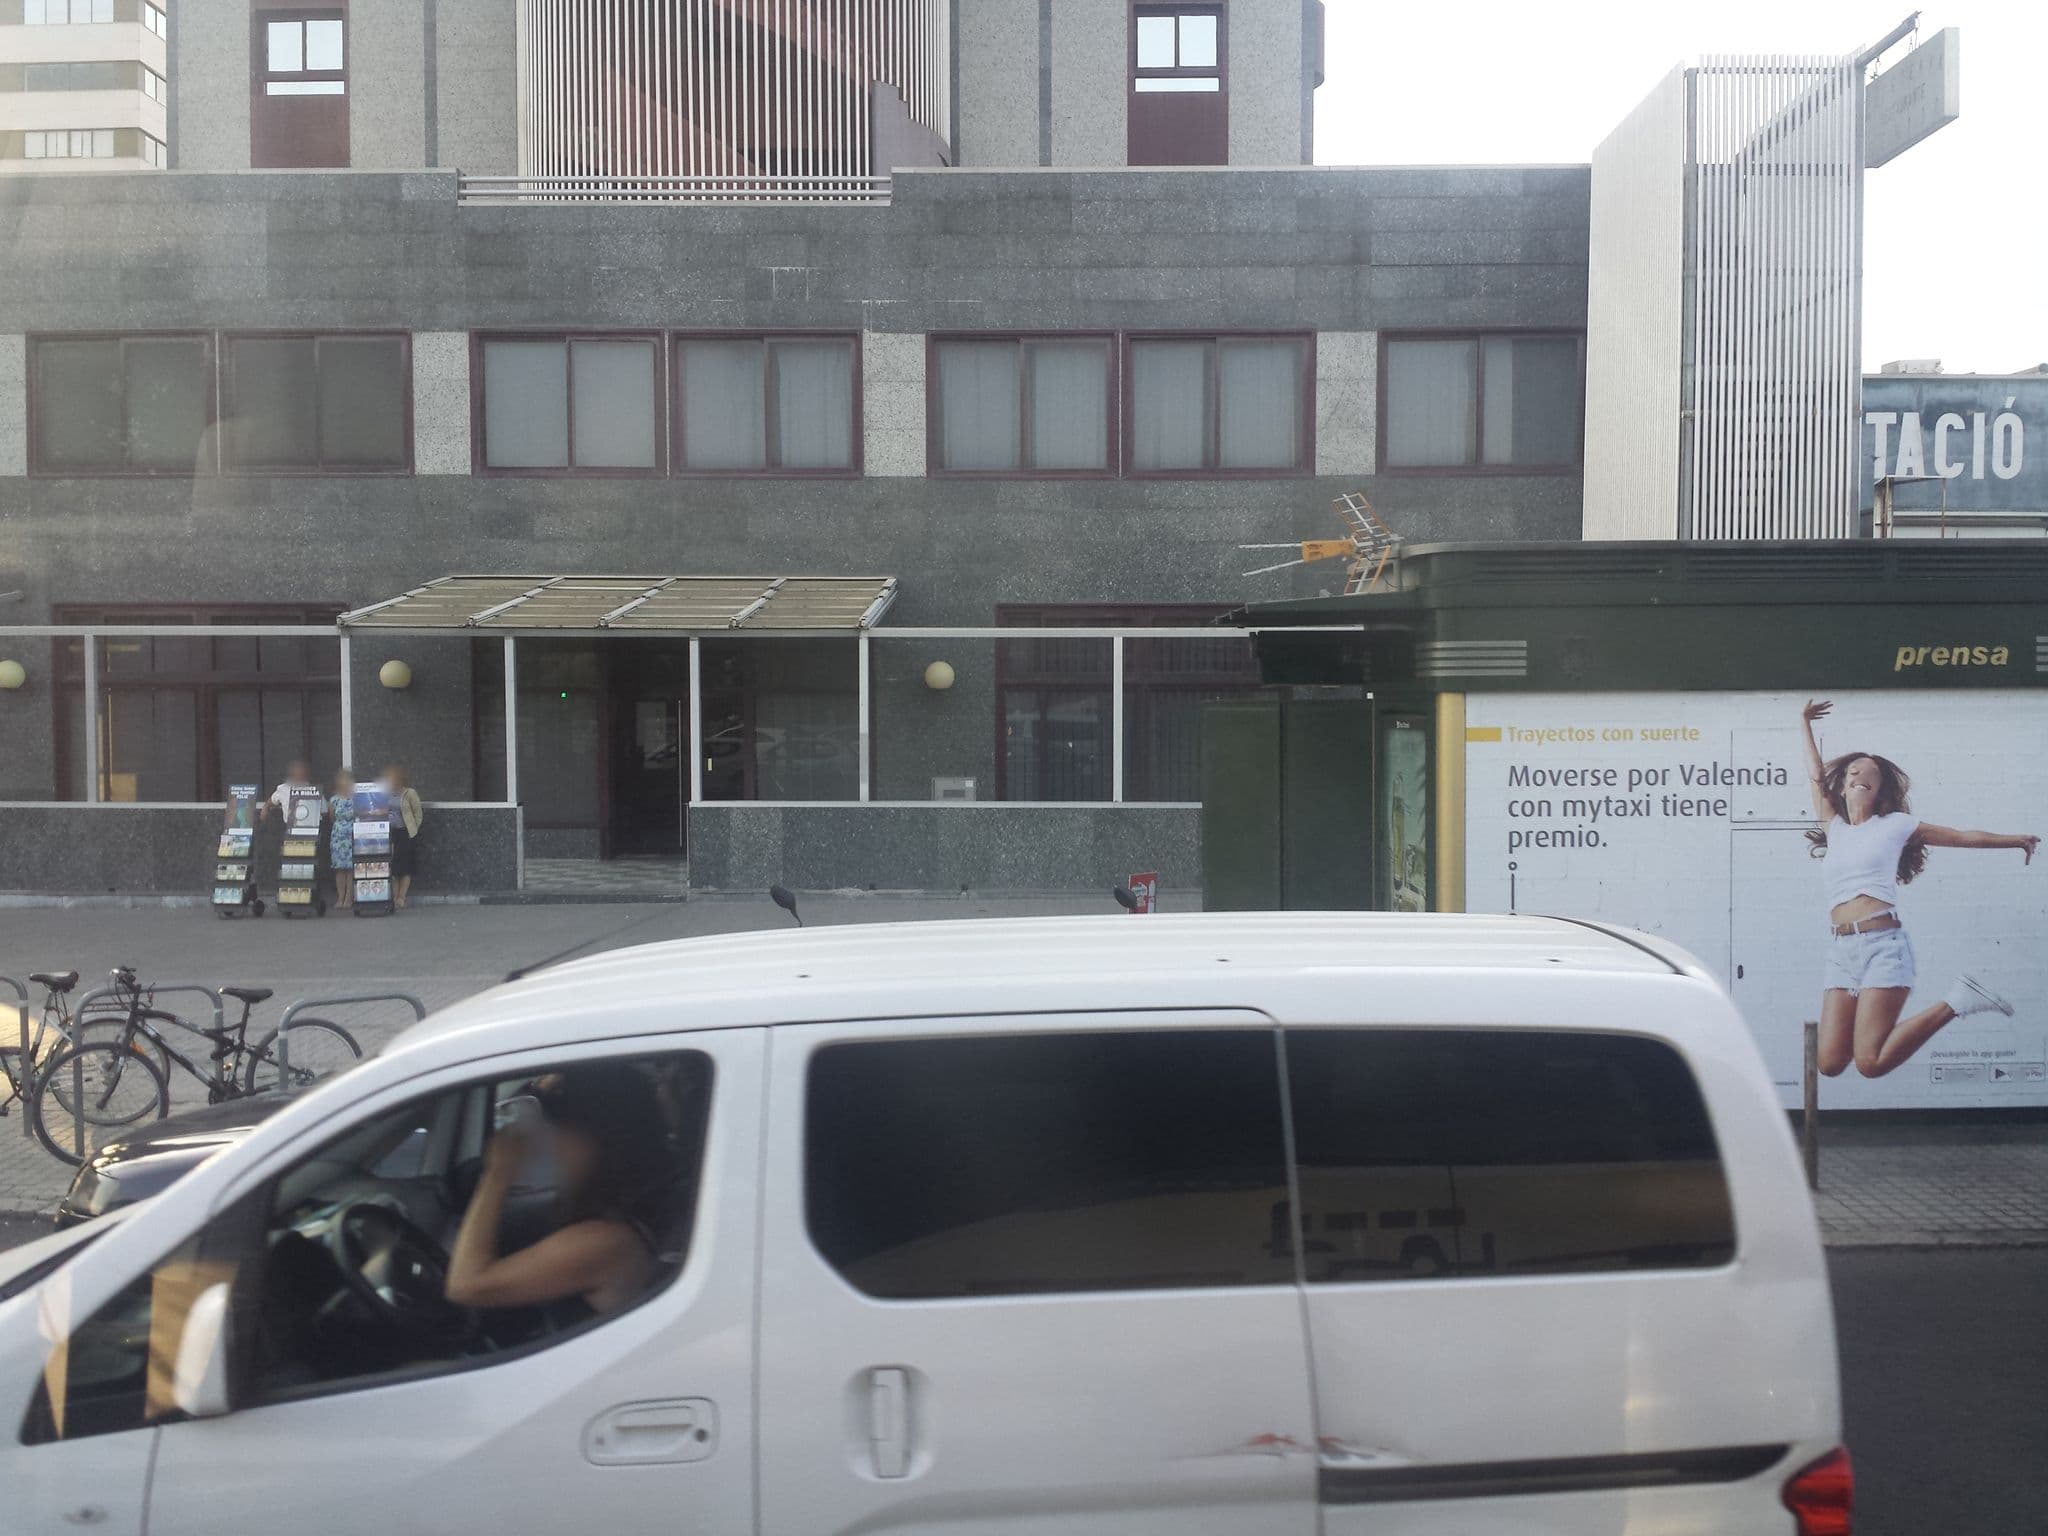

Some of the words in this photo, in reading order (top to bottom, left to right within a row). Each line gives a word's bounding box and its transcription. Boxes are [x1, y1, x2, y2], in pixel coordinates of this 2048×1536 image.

[1865, 396, 2024, 480] TACIÓ
[1894, 646, 2009, 672] prensa
[1508, 727, 1595, 746] Trayectos
[1602, 729, 1633, 741] con
[1640, 728, 1699, 741] suerte
[1508, 765, 1618, 787] Moverse
[1628, 768, 1670, 792] por
[1679, 761, 1788, 786] Valencia
[1508, 799, 1552, 817] con
[1562, 793, 1651, 823] mytaxi
[1661, 793, 1728, 817] tiene
[1508, 824, 1608, 854] premio.
